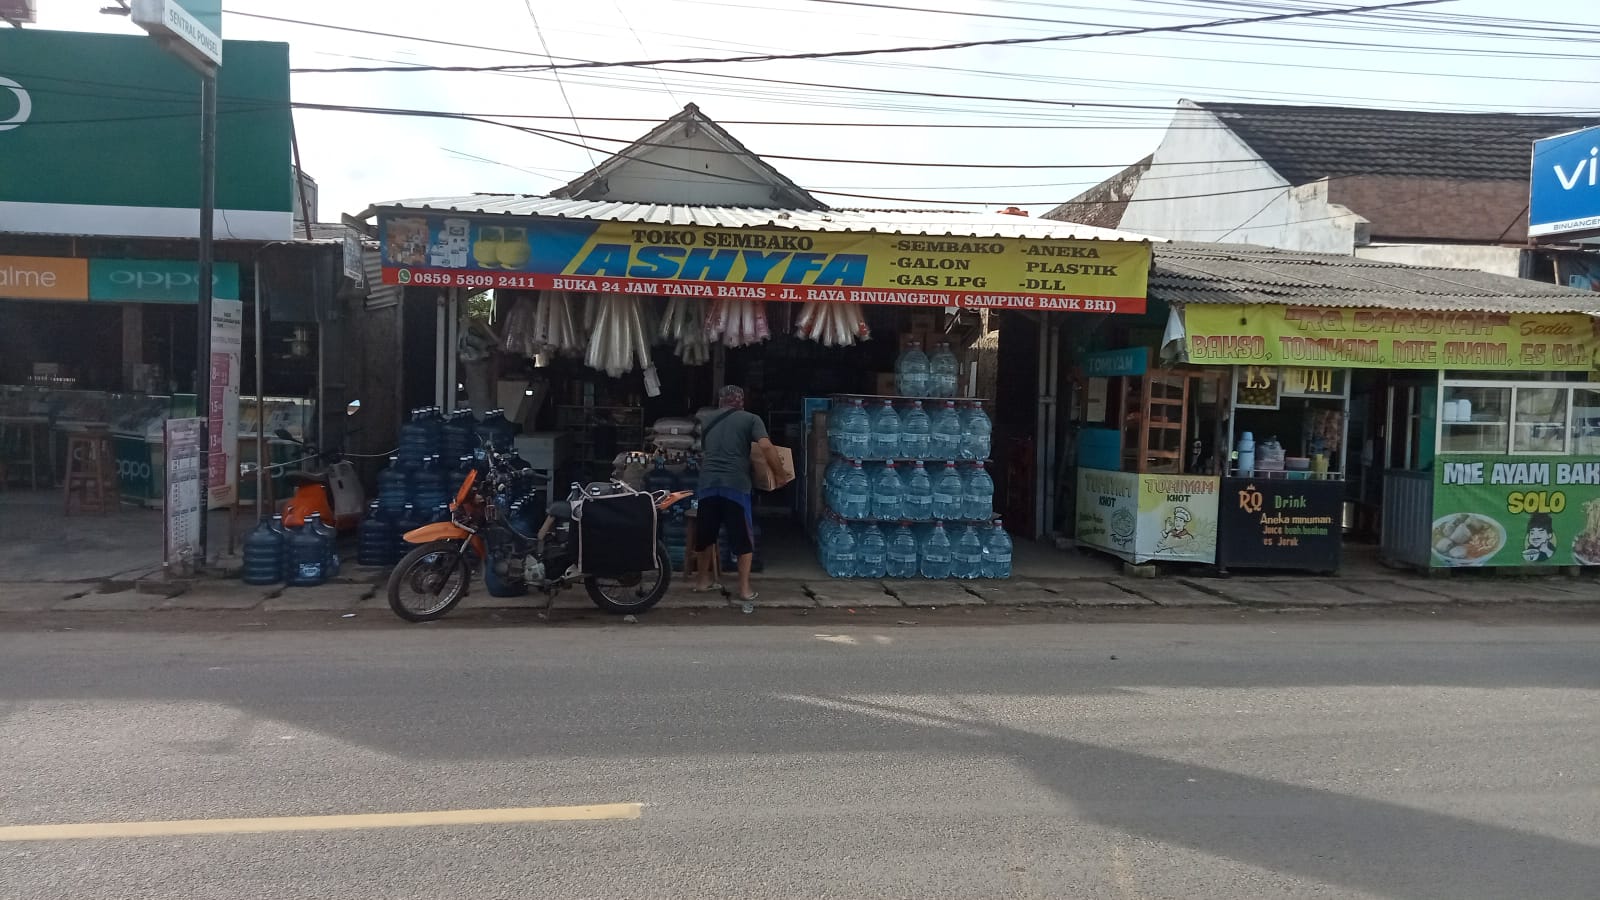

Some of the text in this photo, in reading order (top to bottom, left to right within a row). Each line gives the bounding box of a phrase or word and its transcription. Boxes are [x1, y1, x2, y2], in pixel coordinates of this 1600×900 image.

[170, 9, 219, 56] SENTRAL PONSEL
[1553, 146, 1599, 190] vi
[632, 229, 813, 250] TOKO SEMBAKO
[573, 243, 868, 286] ASHYFA
[1026, 261, 1118, 276] PLASTIK
[414, 273, 535, 288] 0859 5809 2411
[944, 276, 987, 288] LPG
[552, 278, 597, 290] BUKA
[601, 281, 620, 292] 24
[624, 282, 658, 294] JAM
[663, 284, 713, 297] TANPA
[717, 286, 766, 298] BATAS
[780, 288, 802, 300] JL.
[807, 290, 846, 301] RAYA
[850, 291, 950, 305] BINUANGEUN
[964, 295, 1035, 308] SAMPING
[1039, 298, 1080, 310] BANK
[1084, 299, 1117, 313] BRI)
[1352, 311, 1512, 336] BAROKAH
[1520, 320, 1574, 337] Sedia
[1192, 335, 1273, 361] BAKSO,
[1279, 336, 1386, 363] TOMYAM,
[1392, 340, 1437, 364] MIE
[1443, 341, 1513, 367] AYAM,
[1520, 343, 1546, 366] ES
[1442, 462, 1485, 485] MIE
[1490, 462, 1550, 486] AYAM
[1145, 479, 1214, 494] TOMIYAM
[1166, 494, 1191, 503] KHOT
[1274, 495, 1307, 509] Drink
[1507, 491, 1566, 514] SOLO
[1260, 512, 1332, 524] Aneka minuman
